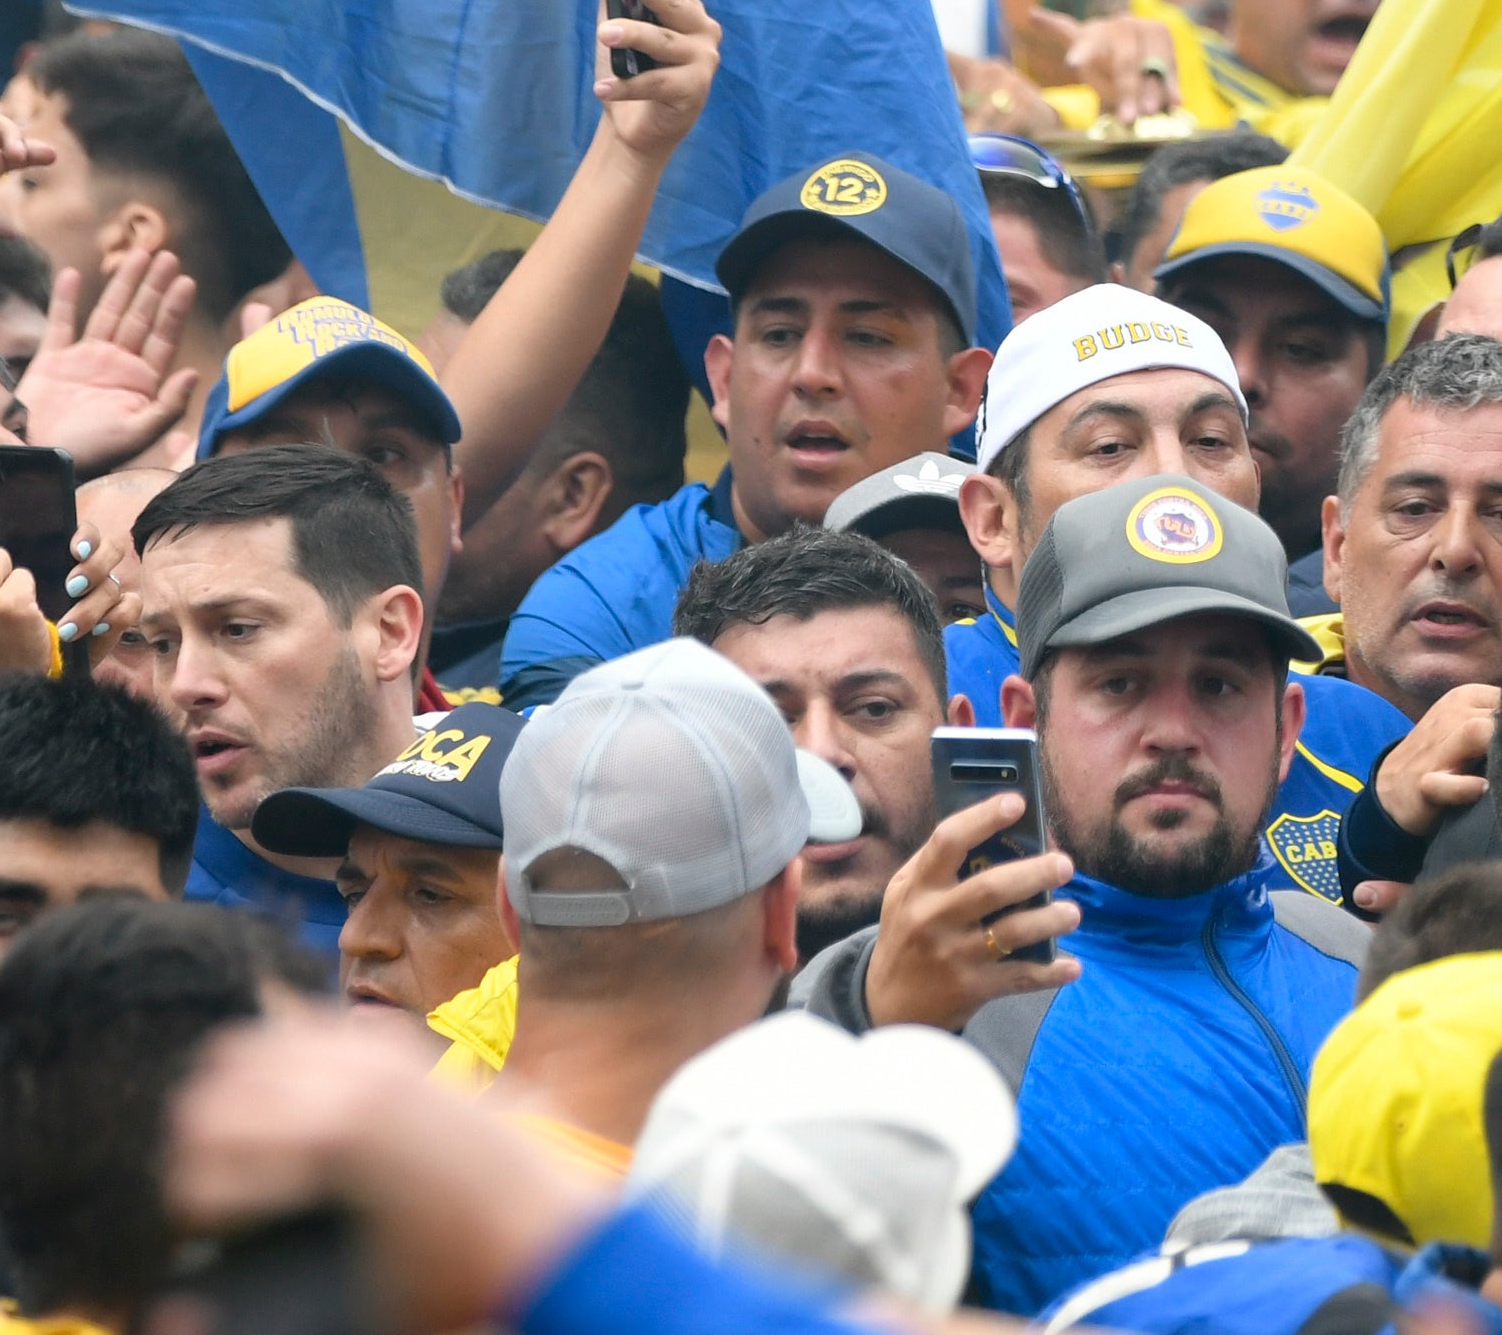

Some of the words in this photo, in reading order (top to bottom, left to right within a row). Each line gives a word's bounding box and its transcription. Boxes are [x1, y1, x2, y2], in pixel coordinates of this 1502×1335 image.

[825, 176, 864, 203] 12
[1072, 321, 1194, 362] BUDGE
[396, 728, 492, 782] OCA
[1285, 840, 1338, 864] CAB
